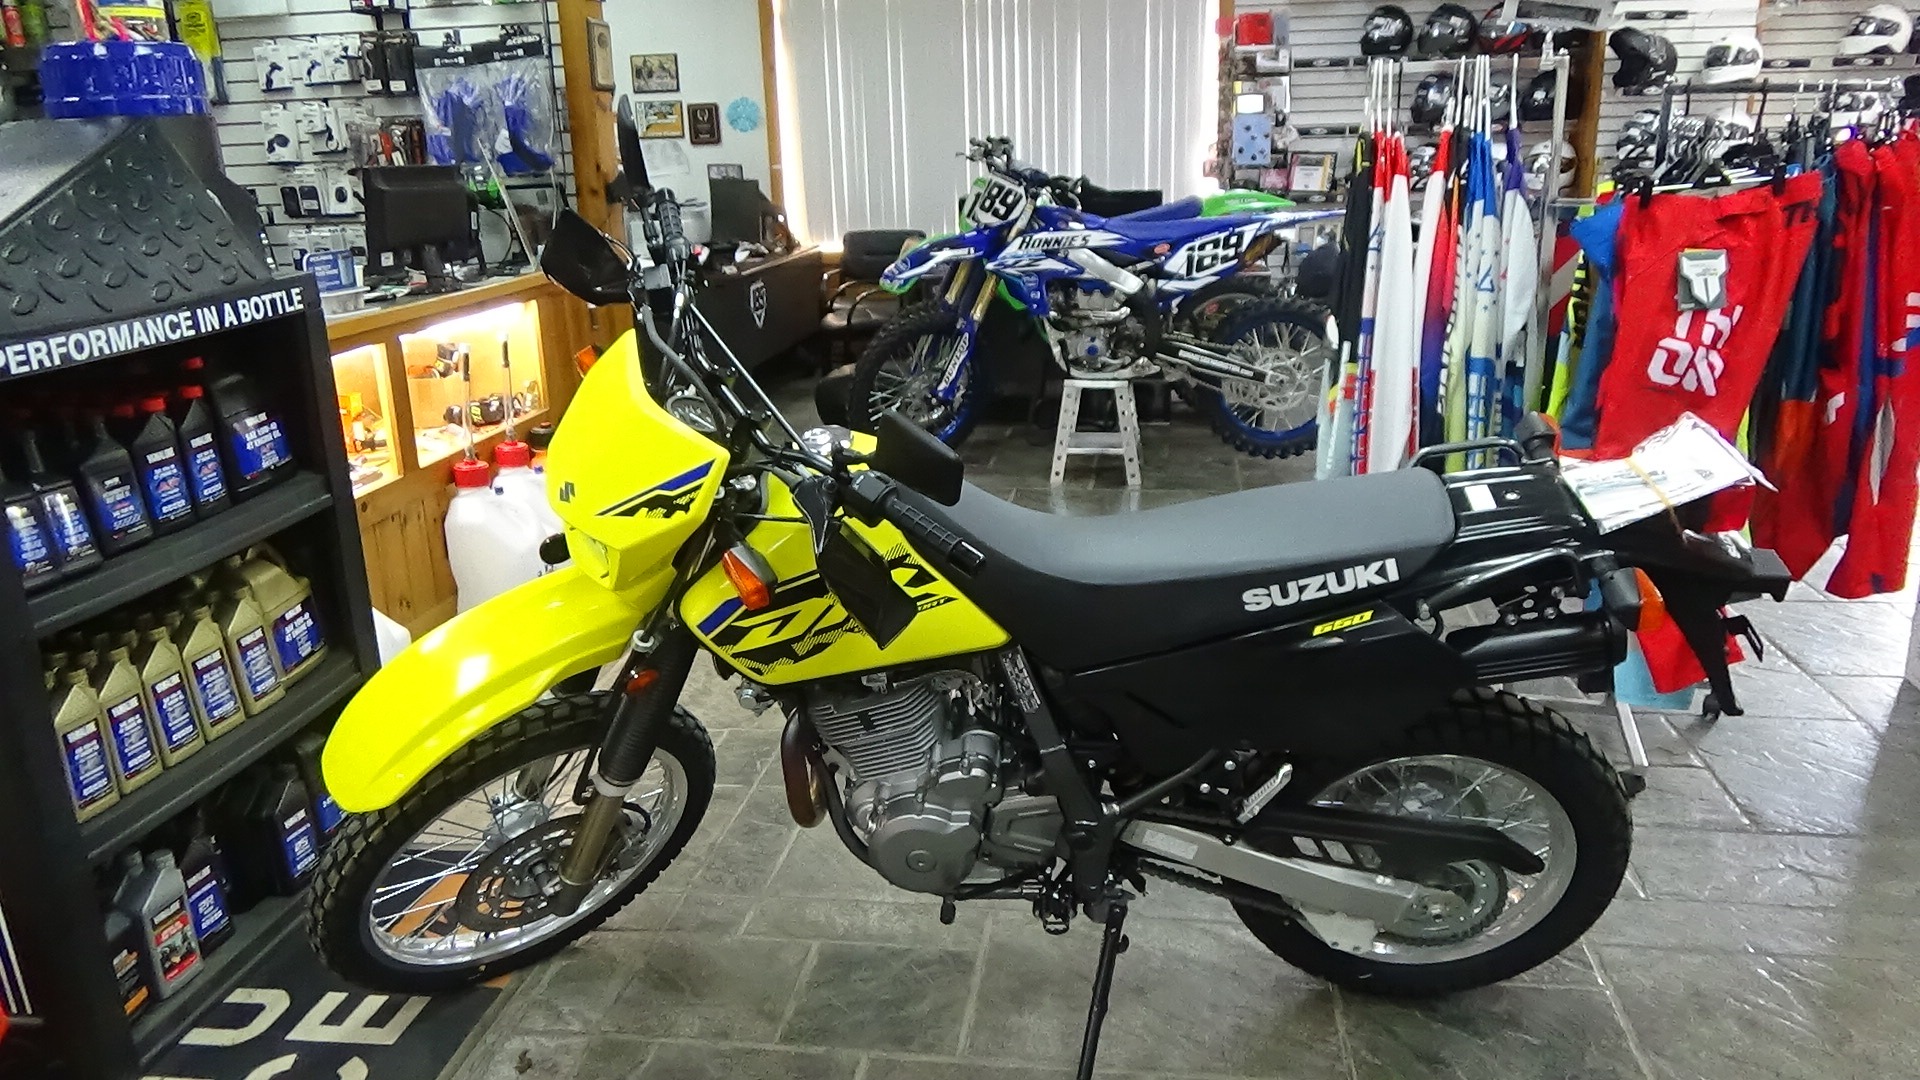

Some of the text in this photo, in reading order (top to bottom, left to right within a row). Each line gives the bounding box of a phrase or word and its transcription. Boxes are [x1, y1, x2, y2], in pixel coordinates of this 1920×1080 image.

[1185, 231, 1245, 278] 189
[196, 306, 220, 333] IN
[223, 303, 238, 328] A
[237, 288, 304, 323] BOTTLE
[1242, 557, 1400, 612] SUZUKI
[1312, 609, 1374, 636] 650
